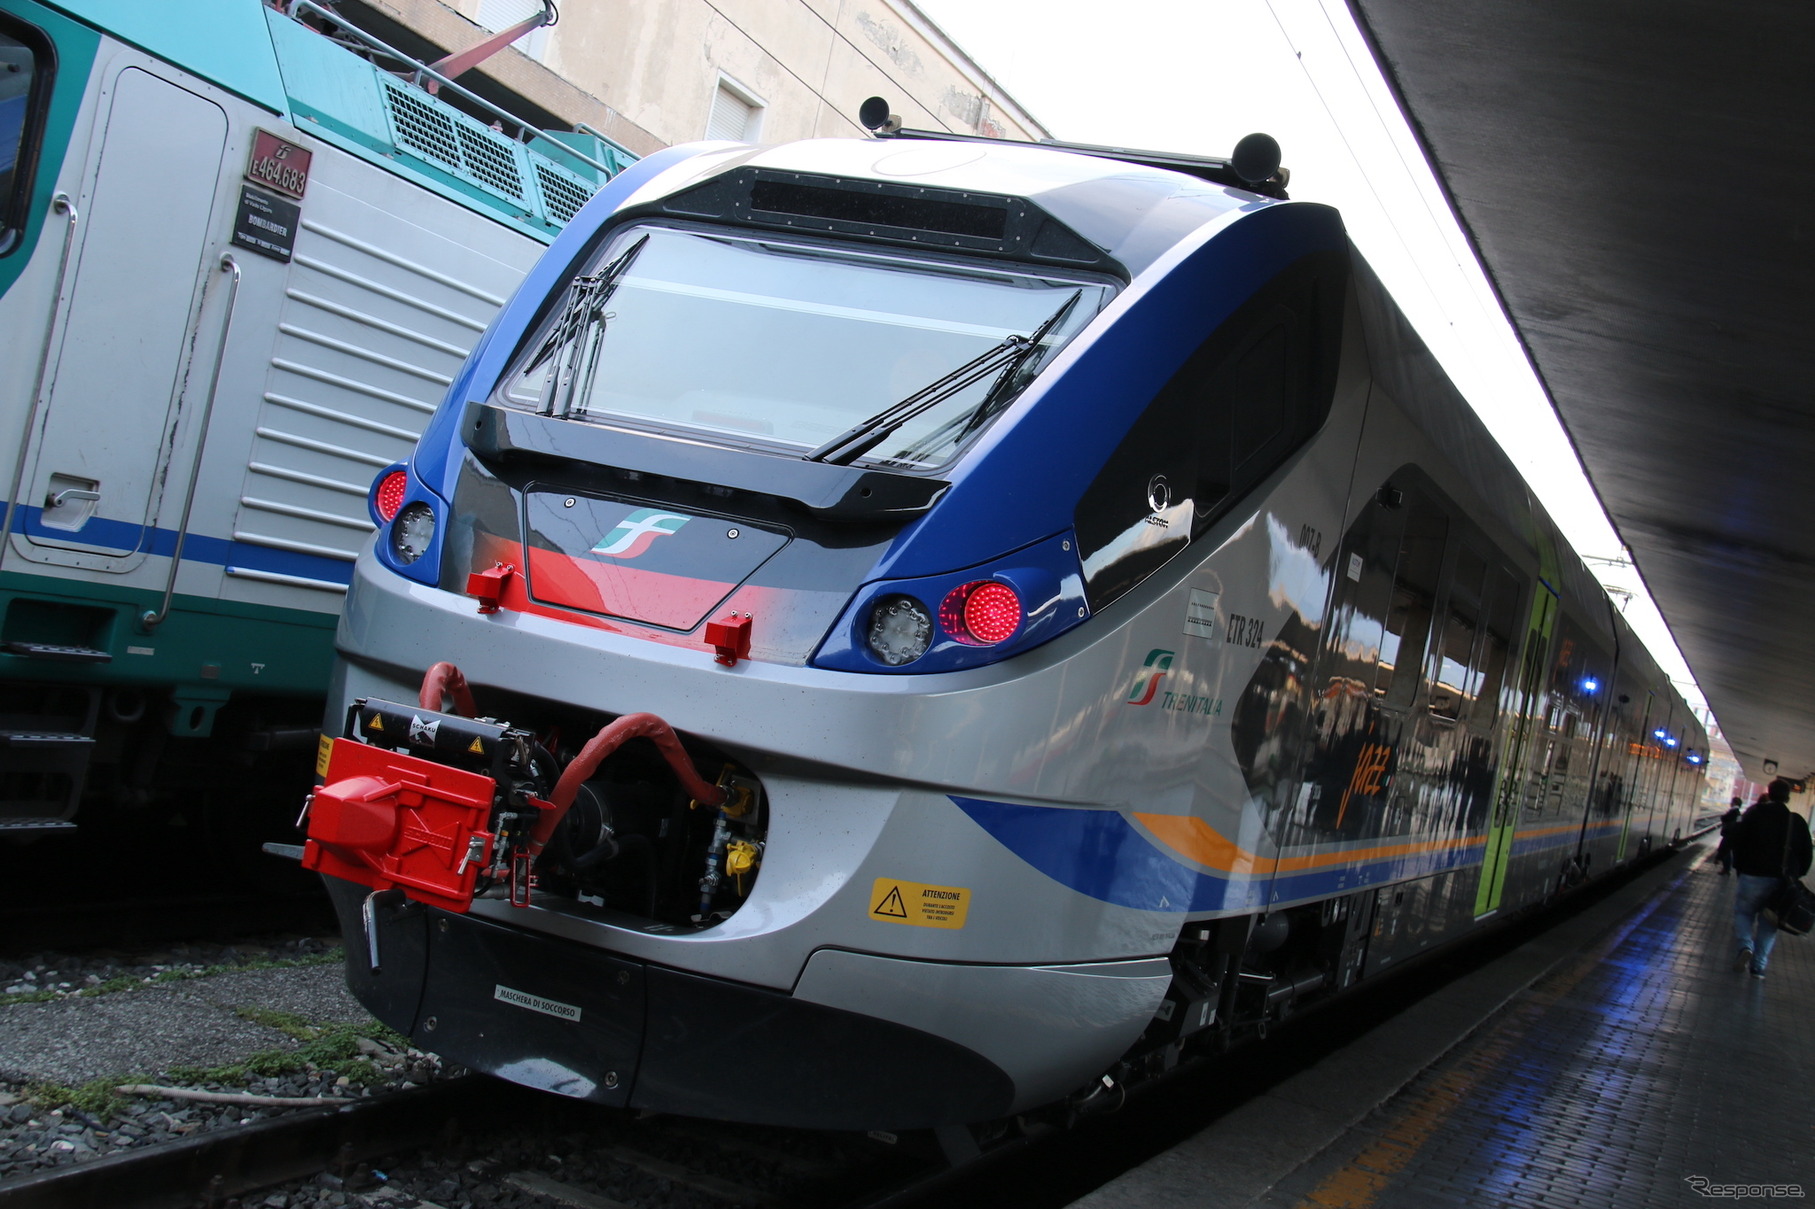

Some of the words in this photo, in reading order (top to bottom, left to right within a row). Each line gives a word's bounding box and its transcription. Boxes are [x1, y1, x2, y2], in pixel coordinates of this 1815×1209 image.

[248, 214, 287, 237] BOMBARDIER
[1226, 613, 1246, 646] ETR
[1245, 618, 1264, 649] 324
[412, 722, 436, 734] SCHAKU
[922, 889, 961, 901] ATTENZIONE
[500, 989, 532, 1006] MASCHERA
[532, 999, 541, 1008] DI
[541, 1001, 576, 1017] SOCCORSO
